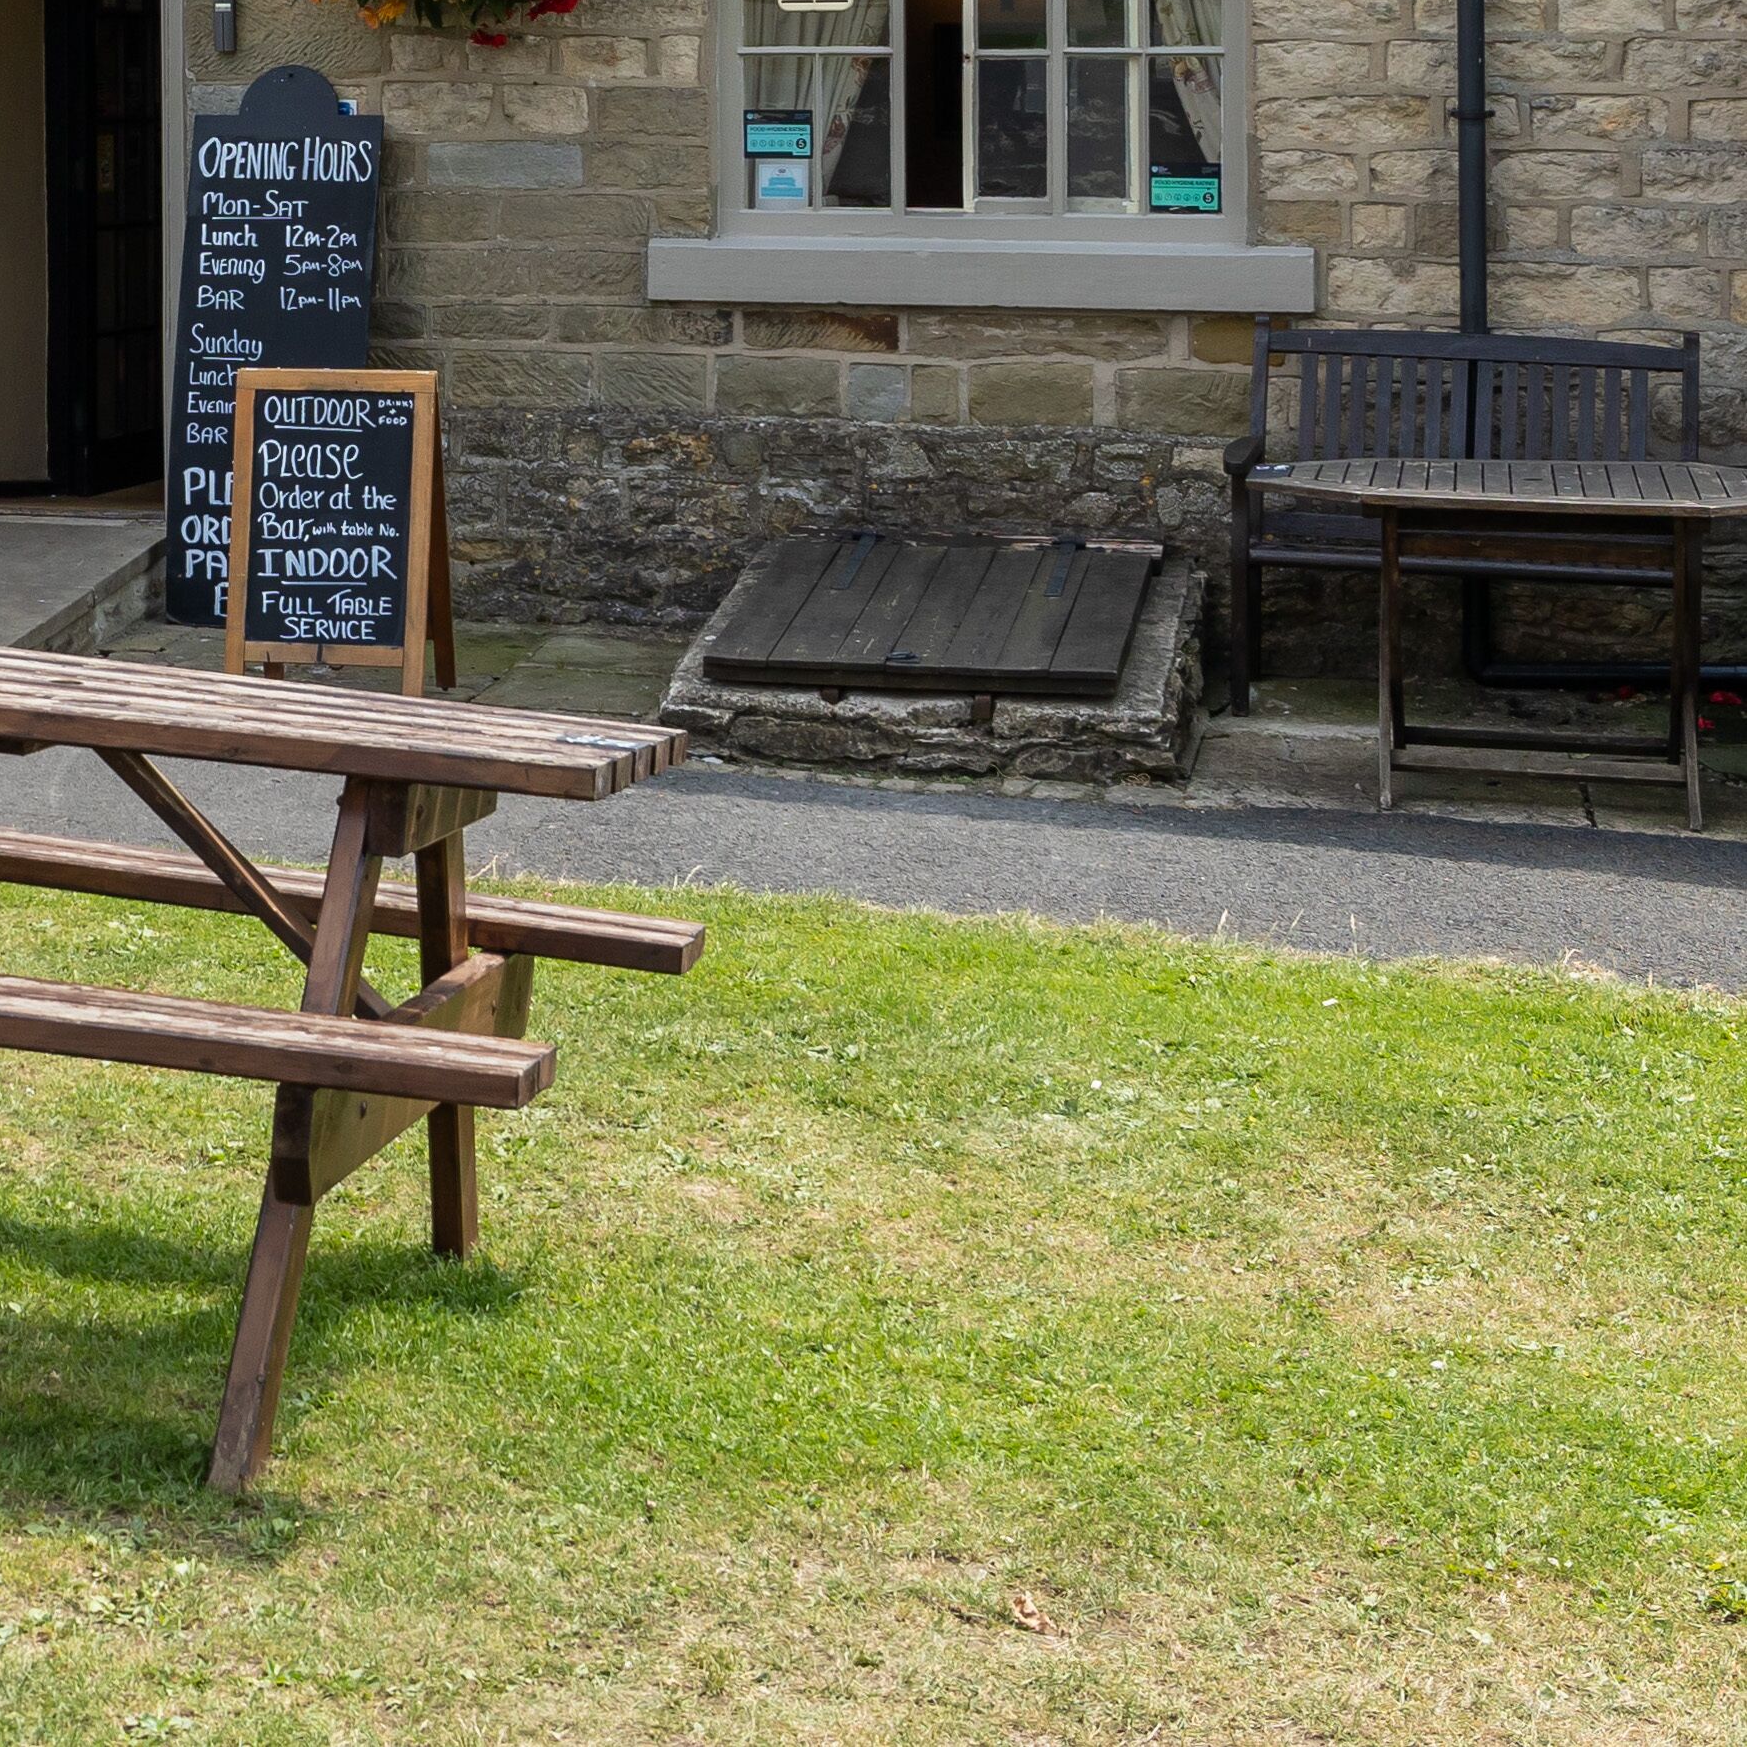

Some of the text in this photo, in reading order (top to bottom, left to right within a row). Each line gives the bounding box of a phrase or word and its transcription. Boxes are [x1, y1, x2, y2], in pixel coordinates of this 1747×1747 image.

[797, 139, 805, 148] 5
[198, 136, 372, 182] OPENING HOURS
[1205, 194, 1212, 203] 5
[201, 223, 258, 247] Lunch
[196, 285, 245, 311] BAR
[189, 322, 263, 362] Sunday
[264, 395, 376, 428] OUTDOOR
[378, 416, 407, 426] FOOD
[186, 422, 228, 444] BAR
[259, 482, 397, 510] Order at the
[258, 511, 400, 542] Bar, with table No.
[257, 545, 398, 580] INDOOR
[262, 589, 392, 616] FULL TABLE
[280, 617, 376, 641] SERVICE
